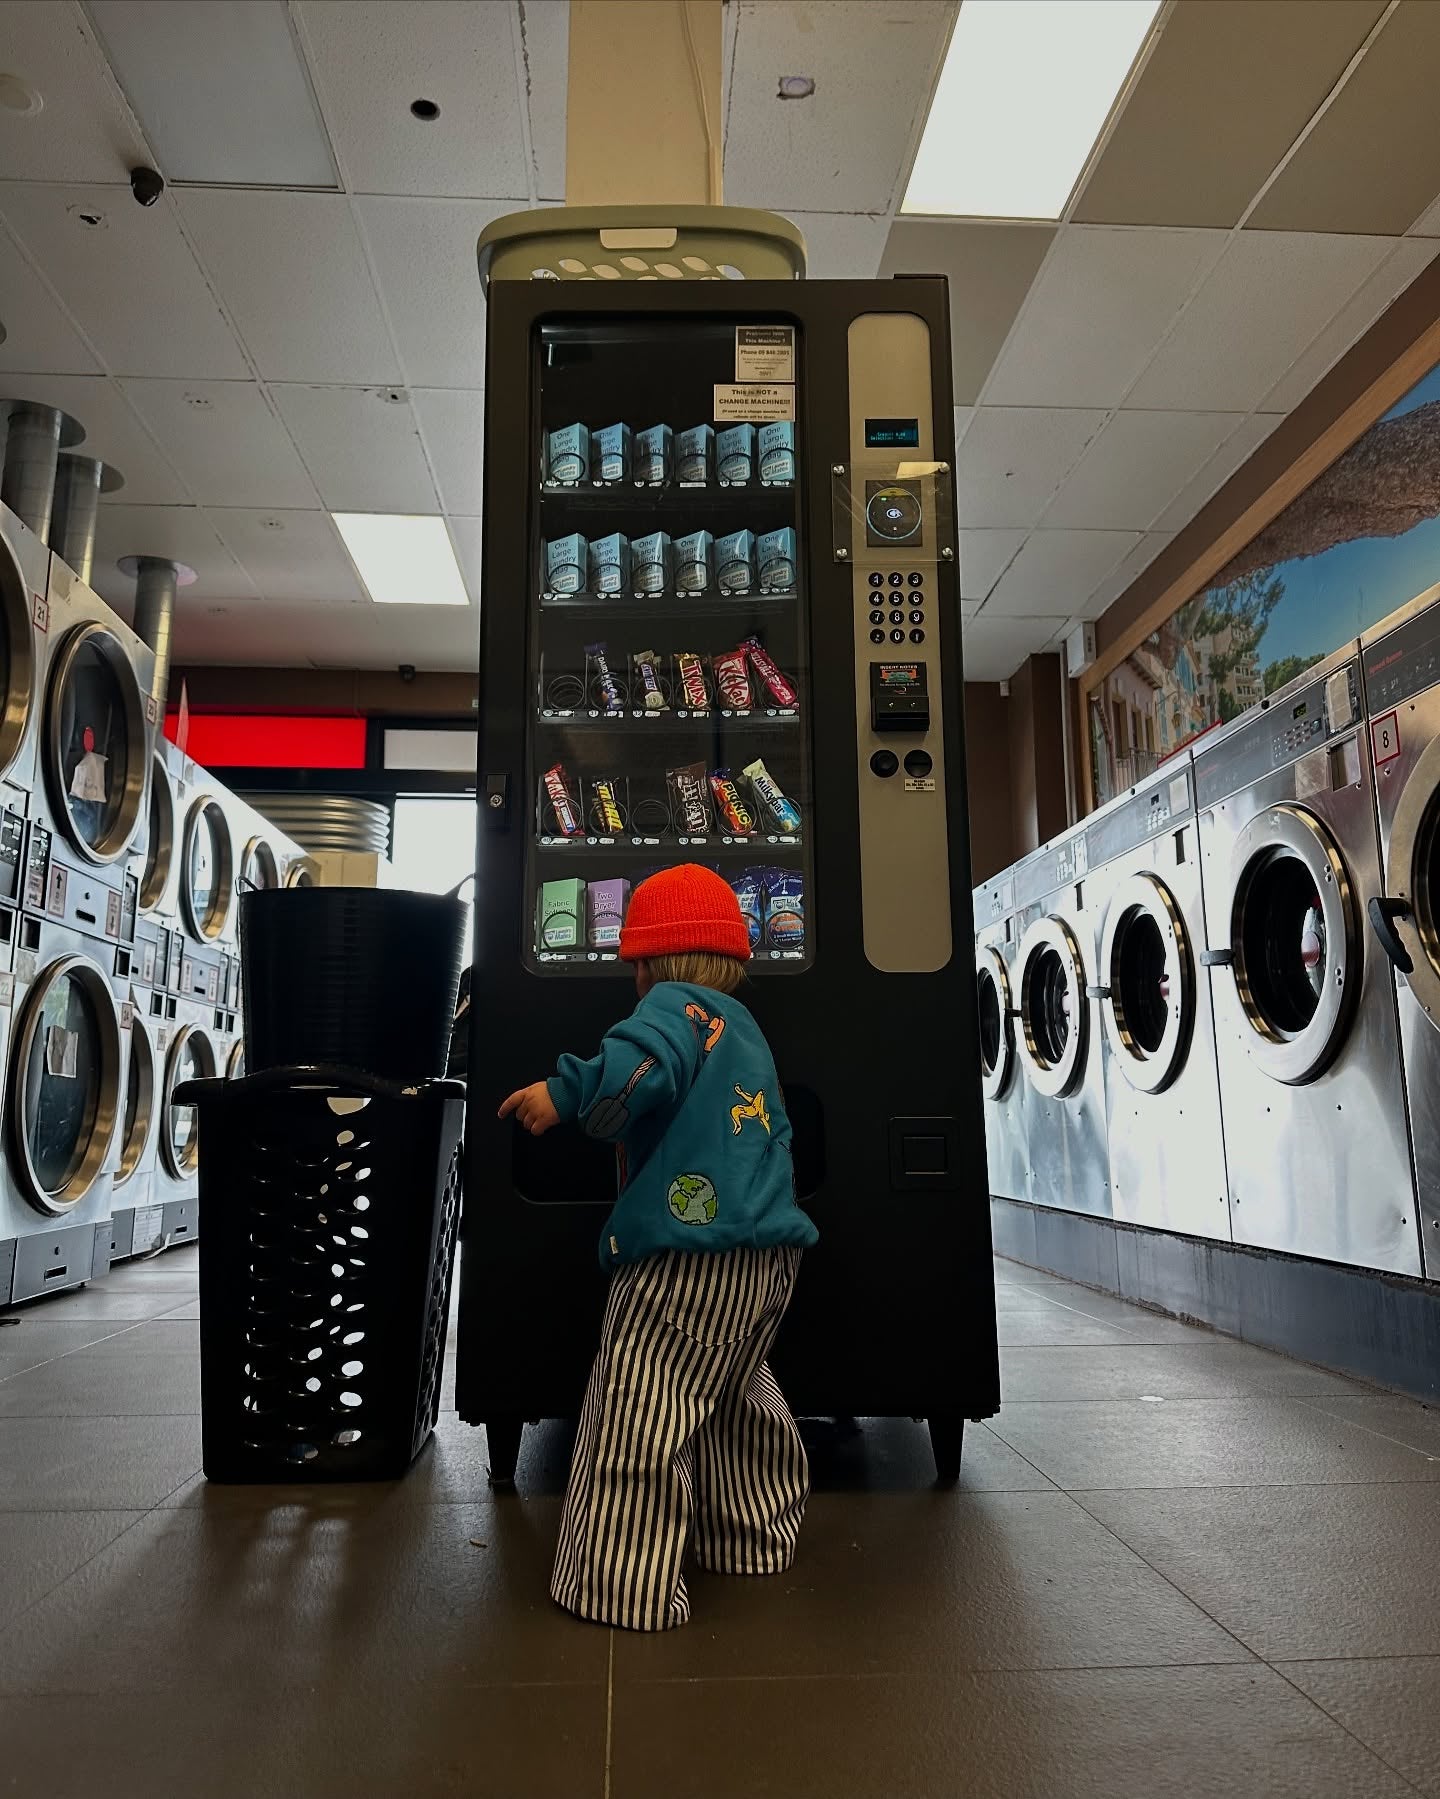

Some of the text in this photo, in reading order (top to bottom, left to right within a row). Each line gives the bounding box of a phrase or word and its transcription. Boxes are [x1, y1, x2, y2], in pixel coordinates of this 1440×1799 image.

[556, 432, 570, 440] One
[766, 427, 780, 436] One
[554, 438, 572, 449] Large
[600, 438, 616, 446] arge
[764, 434, 784, 445] Large
[554, 541, 568, 550] One
[596, 540, 610, 550] One
[638, 540, 652, 548] One
[680, 538, 694, 548] One
[552, 548, 572, 558] Large
[874, 574, 918, 584] 1 2 3
[874, 594, 920, 602] 4 5 6
[38, 606, 45, 622] 21
[874, 612, 920, 622] 7 8 9
[894, 632, 900, 640] 0
[598, 656, 608, 674] DAIRY
[682, 662, 708, 706] TWIX
[1382, 730, 1390, 748] 8
[755, 776, 785, 816] Milkybar
[597, 892, 613, 900] Two
[548, 900, 570, 908] Fabric
[594, 901, 615, 910] Dryer
